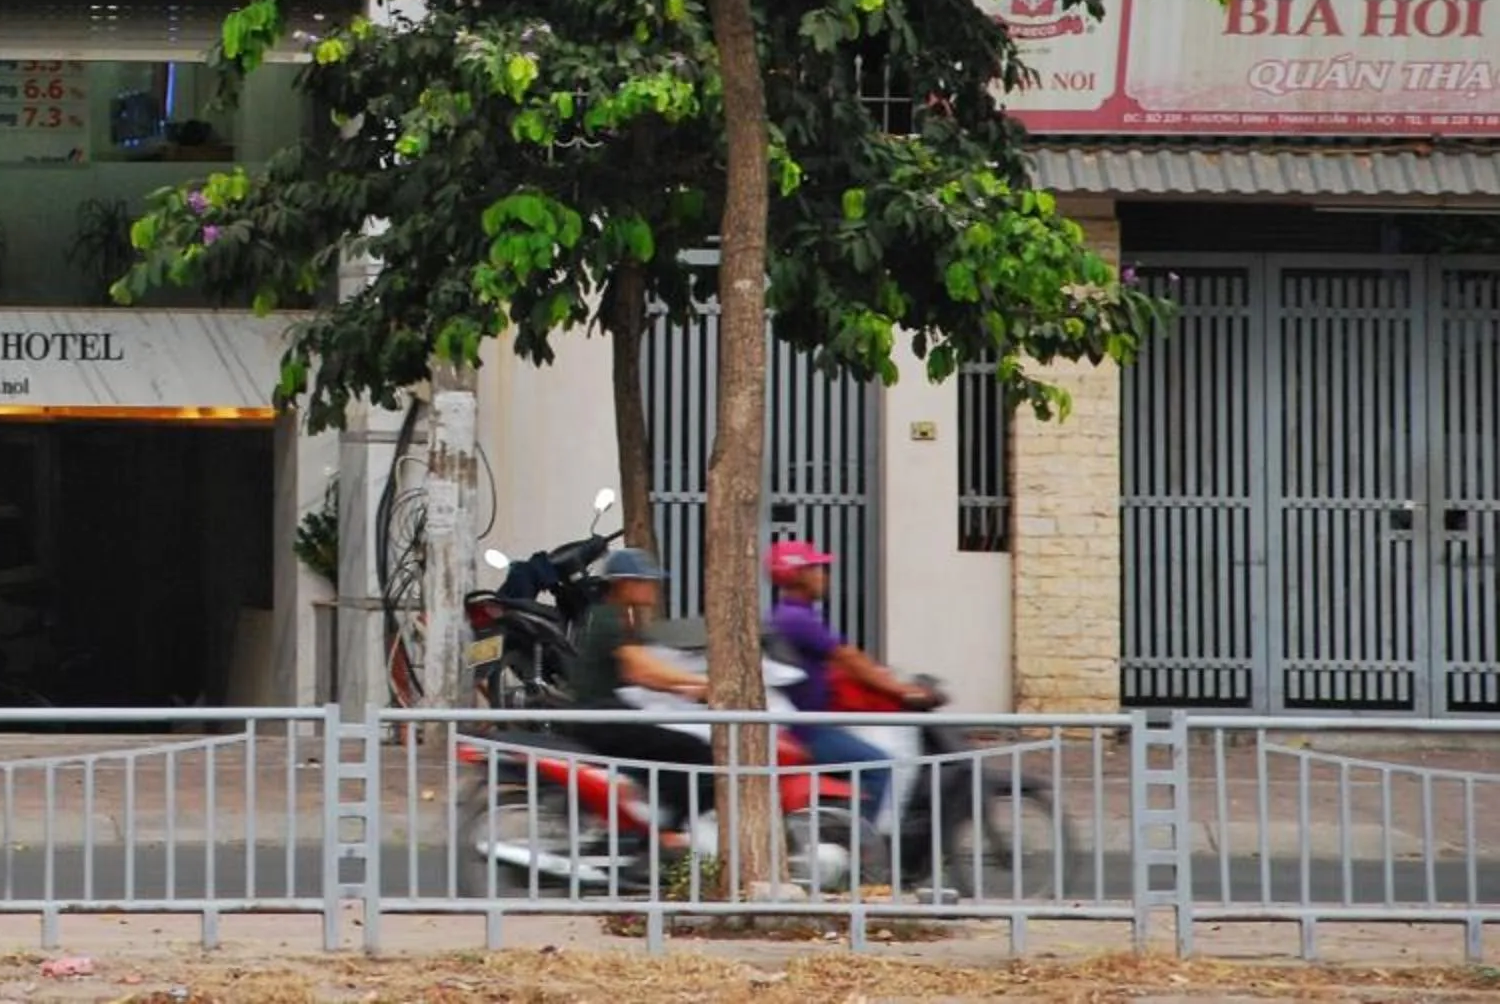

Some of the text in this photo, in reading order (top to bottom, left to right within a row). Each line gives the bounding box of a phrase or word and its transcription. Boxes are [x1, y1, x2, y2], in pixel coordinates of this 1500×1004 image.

[1248, 53, 1500, 99] QUÁN THẠ
[23, 78, 64, 100] 6.6
[22, 106, 63, 128] 7.3
[0, 332, 125, 361] HOTEL
